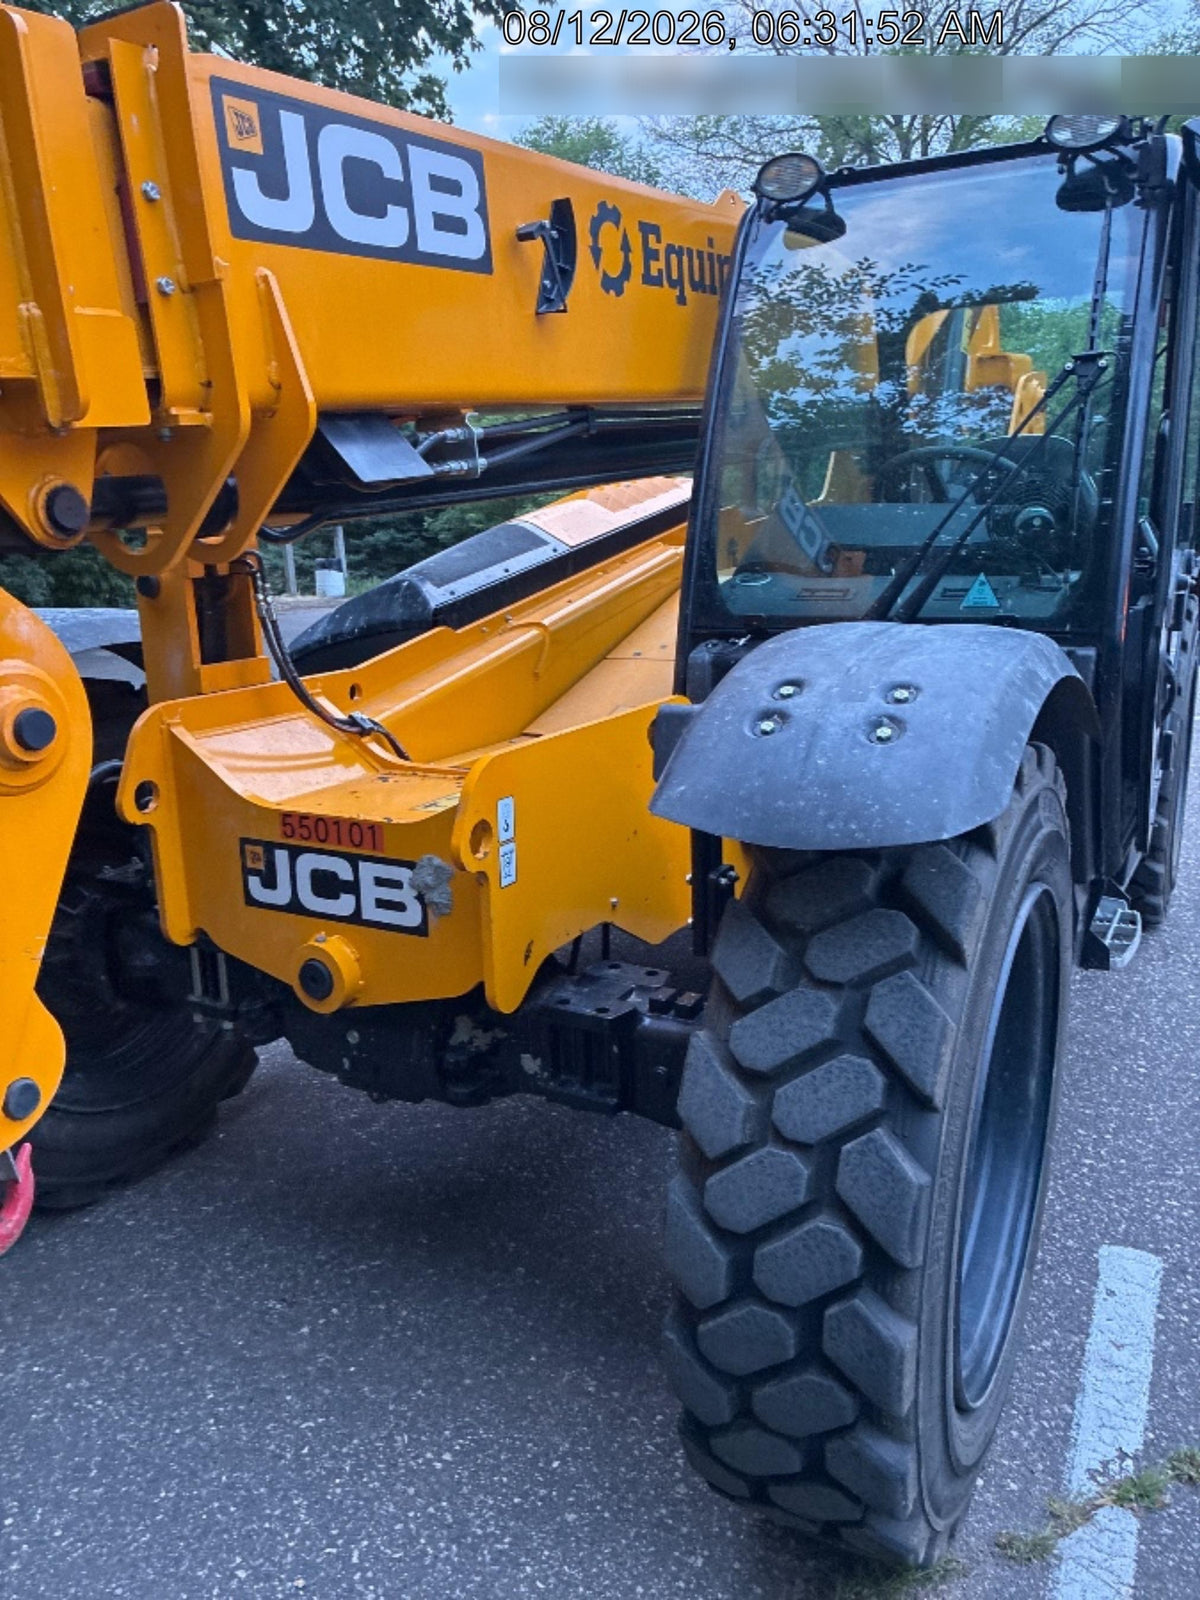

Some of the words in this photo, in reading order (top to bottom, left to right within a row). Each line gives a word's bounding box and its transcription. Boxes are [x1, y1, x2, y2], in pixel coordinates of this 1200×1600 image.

[231, 109, 486, 260] JCB
[281, 813, 378, 850] 550101
[248, 850, 423, 927] JCB
